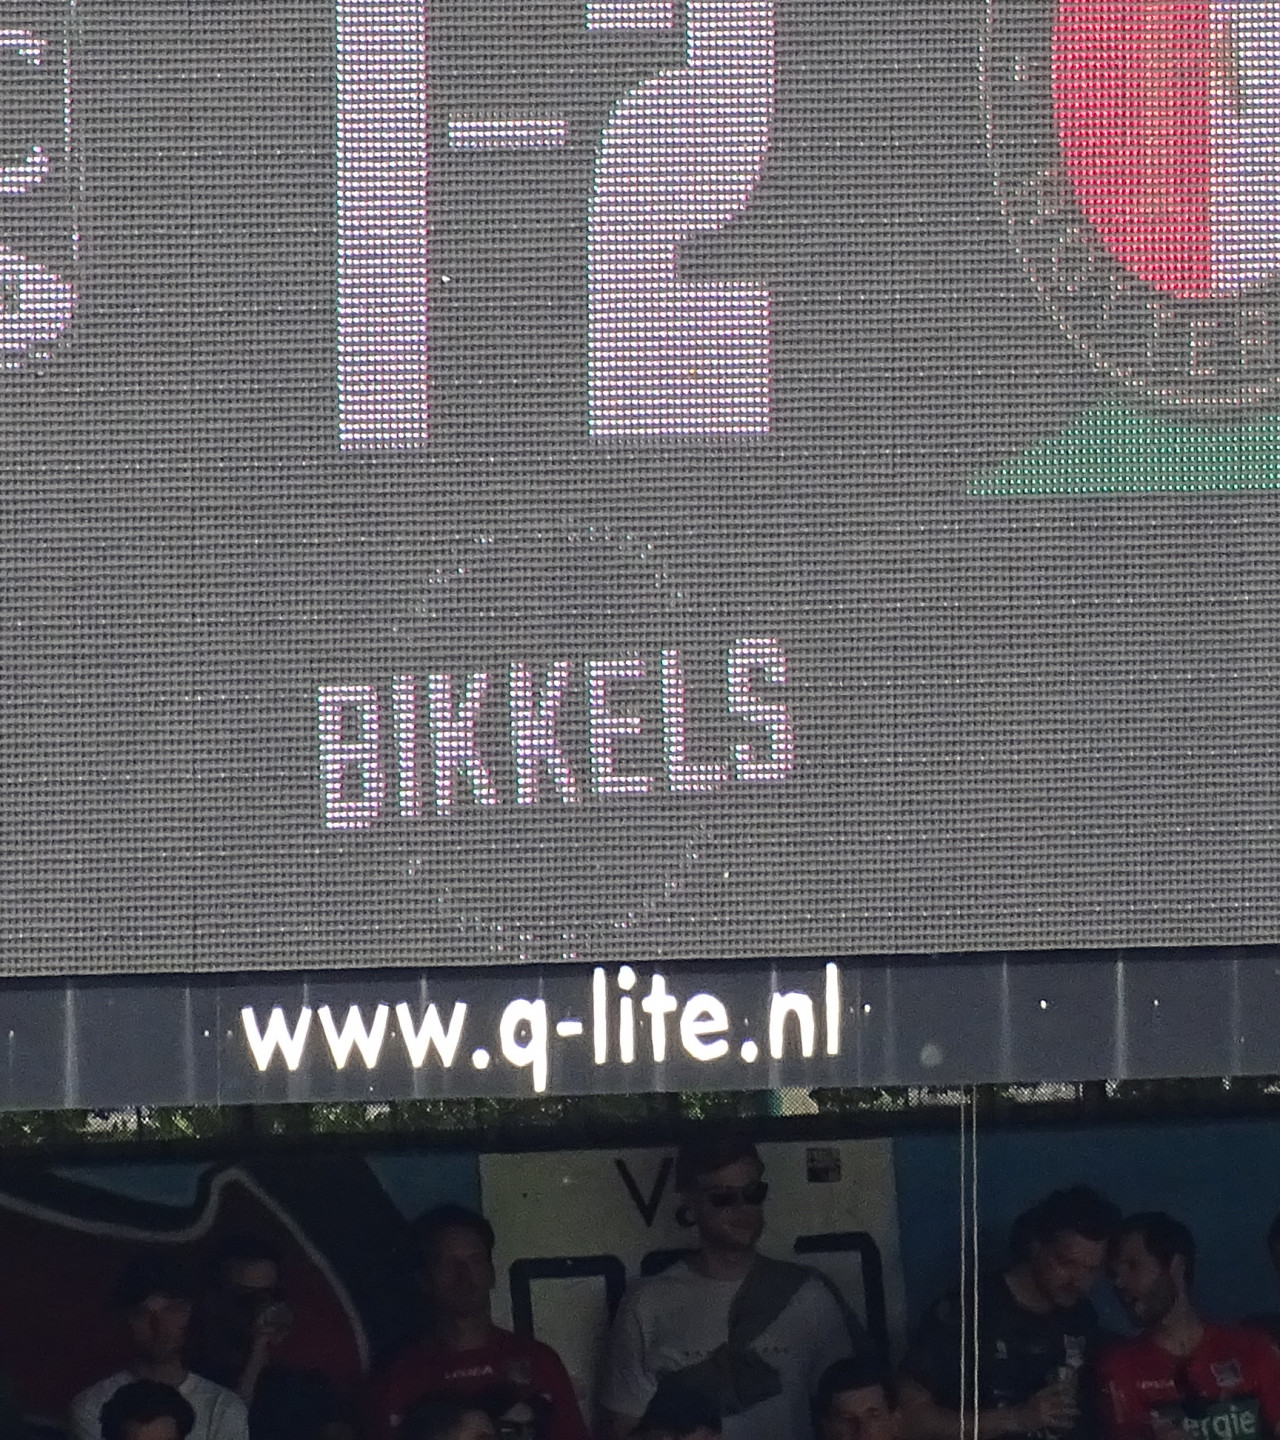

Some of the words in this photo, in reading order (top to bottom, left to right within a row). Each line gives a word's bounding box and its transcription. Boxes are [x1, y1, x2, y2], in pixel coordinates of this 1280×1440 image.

[318, 636, 795, 829] BIKKELS
[241, 962, 841, 1092] www.q-lite.nl
[1182, 1402, 1256, 1440] ergie
